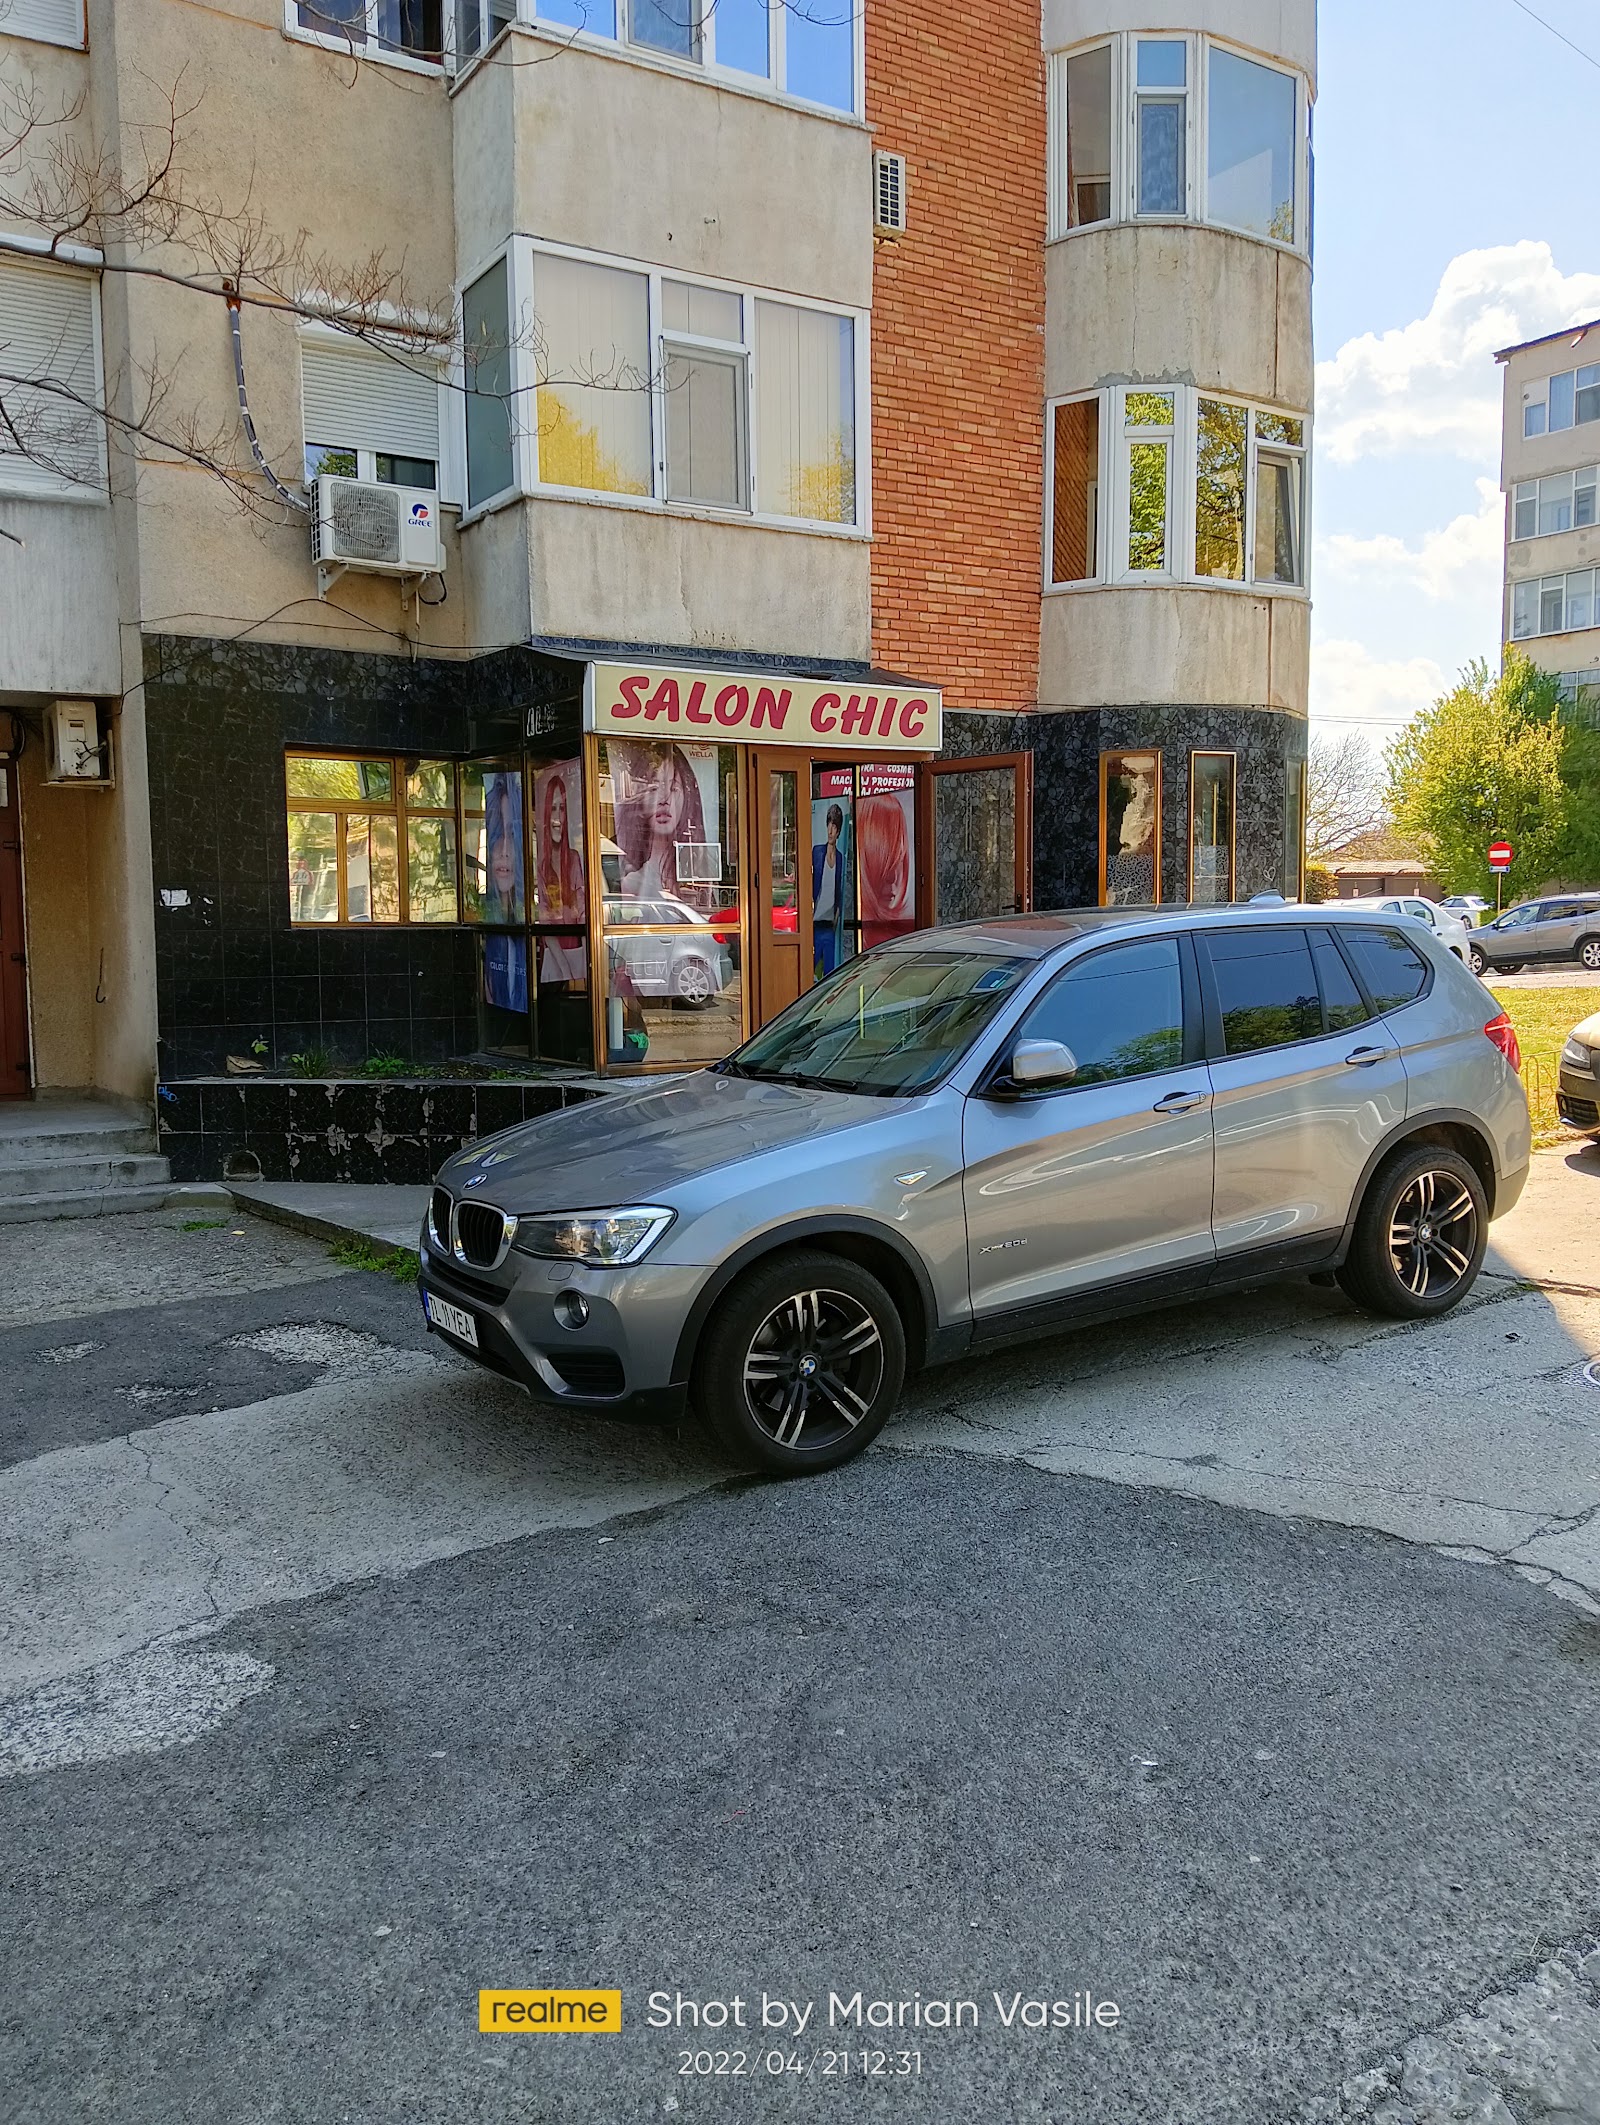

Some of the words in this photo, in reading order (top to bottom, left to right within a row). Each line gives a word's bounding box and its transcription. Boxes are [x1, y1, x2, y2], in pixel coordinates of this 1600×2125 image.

[408, 518, 433, 527] GREE
[611, 676, 792, 729] SALON
[810, 693, 928, 738] CHIC
[689, 750, 714, 758] WELLA
[625, 958, 712, 976] ELEMENTS
[429, 1297, 441, 1323] TL
[450, 1308, 473, 1341] YEA
